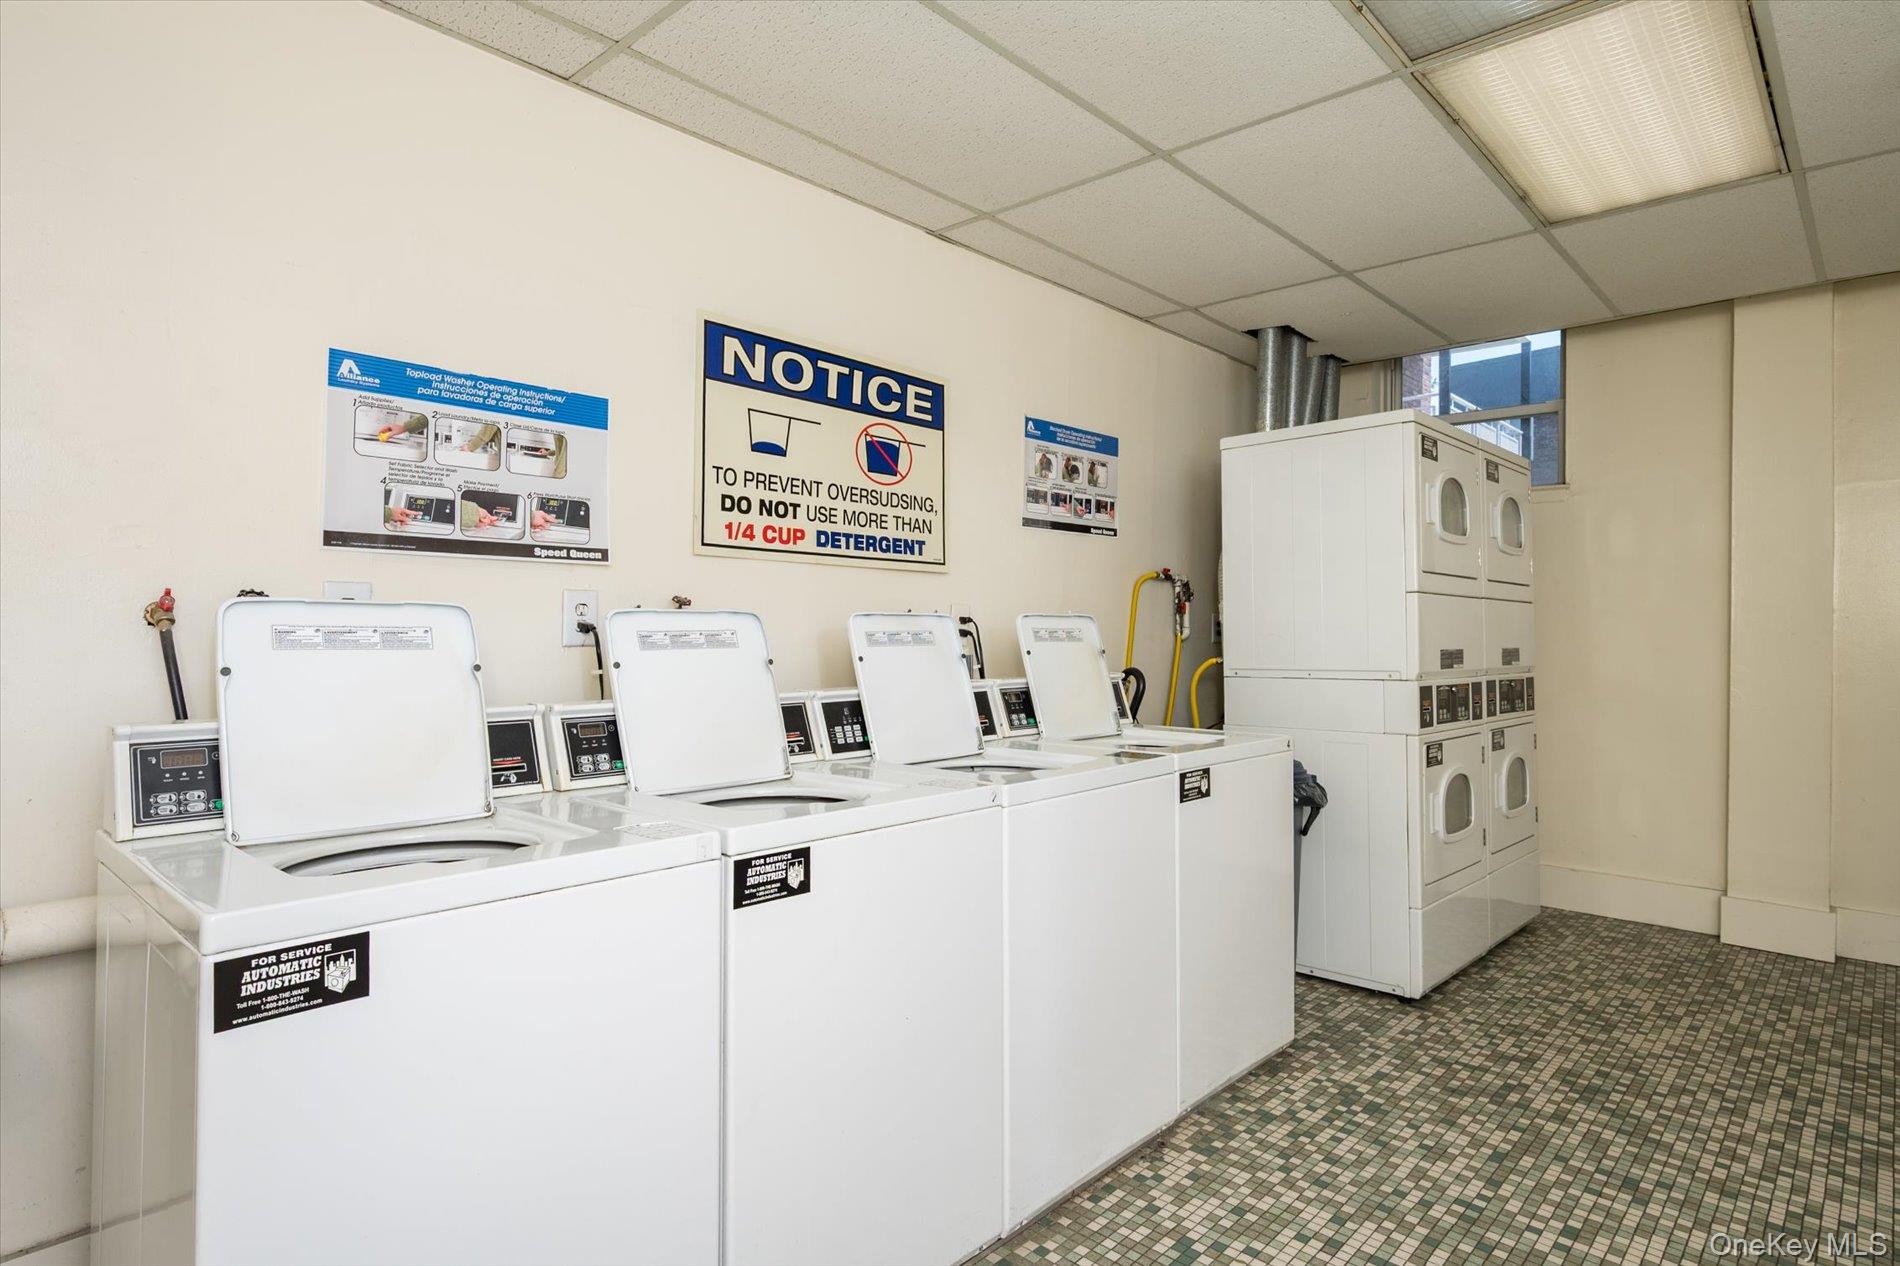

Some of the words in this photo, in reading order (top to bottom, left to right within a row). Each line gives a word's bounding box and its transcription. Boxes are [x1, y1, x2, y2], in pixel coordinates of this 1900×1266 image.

[405, 368, 442, 381] Topload
[444, 374, 475, 387] Washer
[476, 380, 518, 395] Operating
[519, 388, 566, 404] Instructions/
[432, 381, 488, 398] Instrucciones
[490, 390, 501, 399] de
[722, 335, 933, 422] NOTICE
[353, 398, 357, 407] 1
[417, 387, 439, 398] para
[441, 389, 483, 403] lavadoras
[485, 395, 497, 405] de
[498, 400, 523, 411] carga
[525, 404, 556, 416] superior
[432, 410, 438, 419] 2
[503, 421, 509, 429] 3
[380, 476, 387, 484] 4
[457, 484, 463, 492] 5
[712, 465, 737, 486] TO
[743, 470, 823, 498] PREVENT
[827, 483, 939, 516] OVERSUDSING,
[720, 493, 752, 514] DO
[758, 498, 801, 520] NOT
[806, 504, 838, 525] USE
[842, 508, 888, 530] MORE
[892, 515, 932, 535] THAN
[724, 521, 756, 542] 1/4
[762, 524, 806, 545] CUP
[815, 530, 926, 557] DETERGENT
[533, 547, 567, 558] Speed
[569, 549, 602, 559] Queen
[746, 861, 787, 877] AUTOMATIC
[751, 858, 765, 866] FOR
[766, 853, 792, 863] SERVICE
[746, 870, 786, 886] INDUSTRIES
[251, 954, 277, 968] FOR
[280, 943, 332, 962] SERVICE
[241, 955, 322, 984] AUTOMATIC
[240, 968, 321, 997] INDUSTRIES
[236, 1001, 247, 1010] Toll
[248, 999, 262, 1007] Free
[262, 986, 310, 1004] 1-800-THE-WASH
[232, 998, 323, 1025] www.automaticindustries.com
